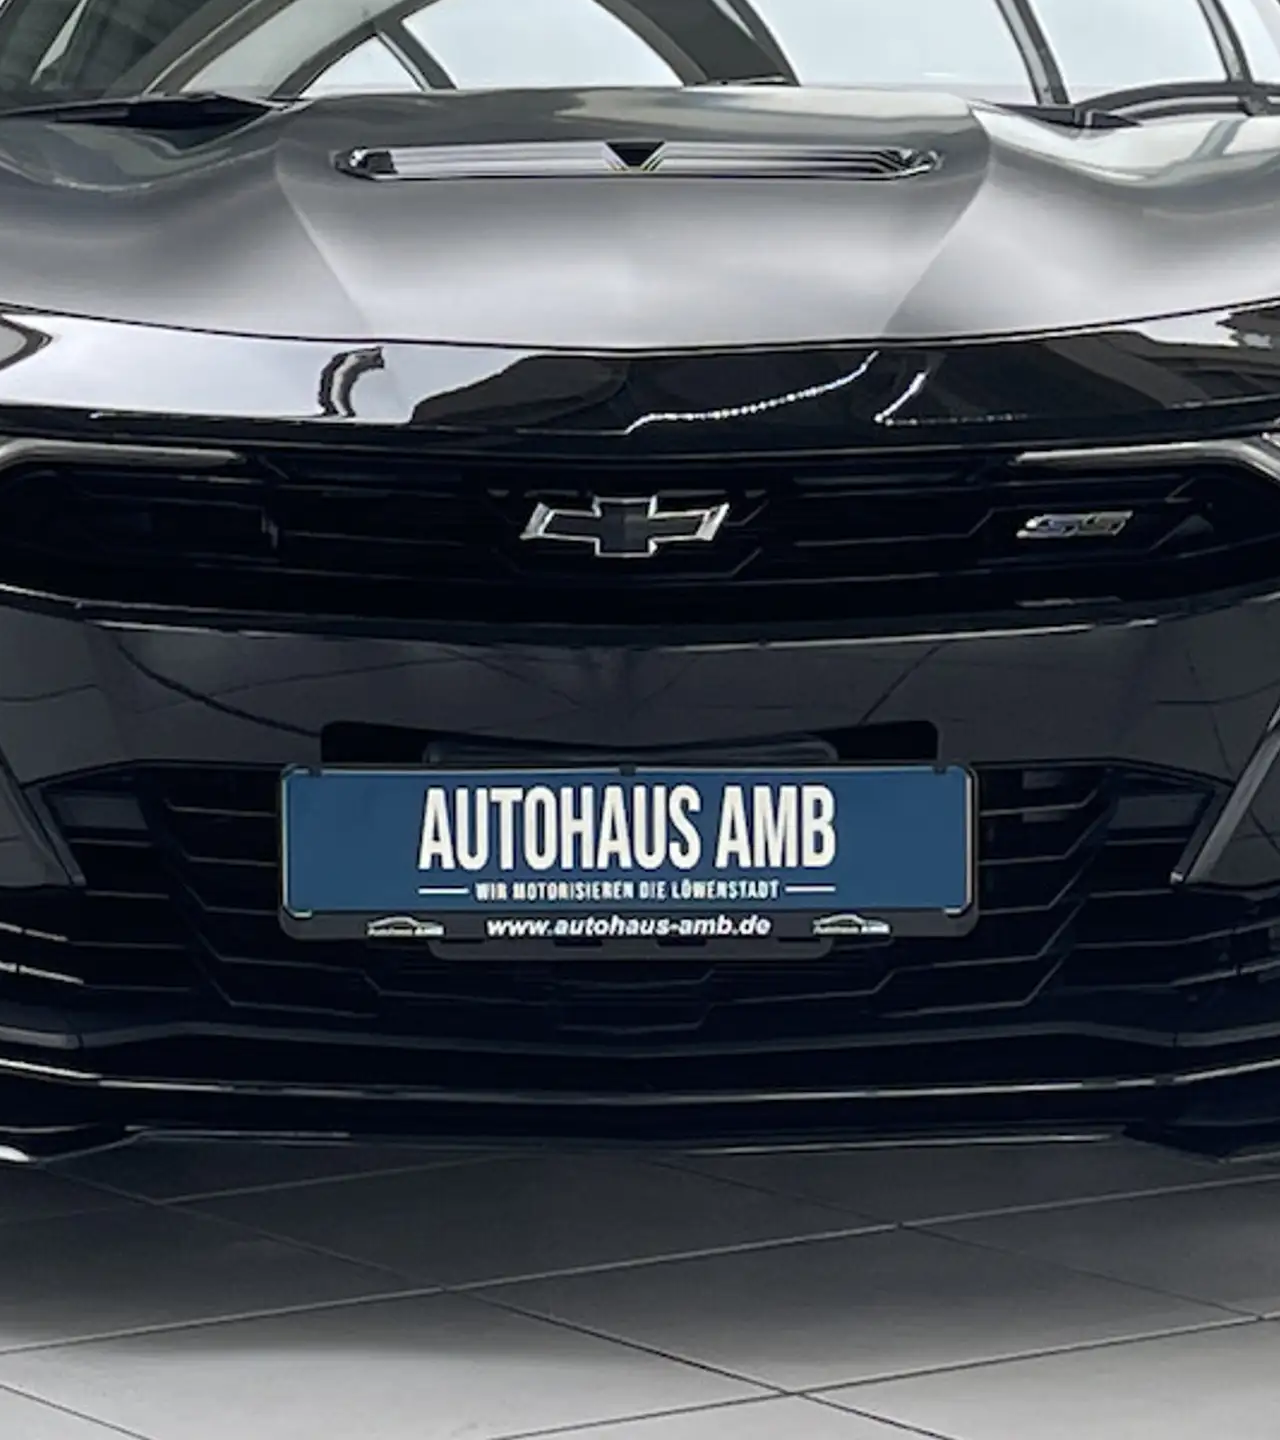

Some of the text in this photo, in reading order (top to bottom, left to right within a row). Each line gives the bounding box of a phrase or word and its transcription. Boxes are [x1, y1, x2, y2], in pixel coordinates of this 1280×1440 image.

[418, 784, 837, 871] AUTOHAUS AMB
[475, 878, 780, 901] WIR MOTORISIEREN DIE LÖWENSTADT
[486, 914, 772, 937] www.autohaus-amb.de
